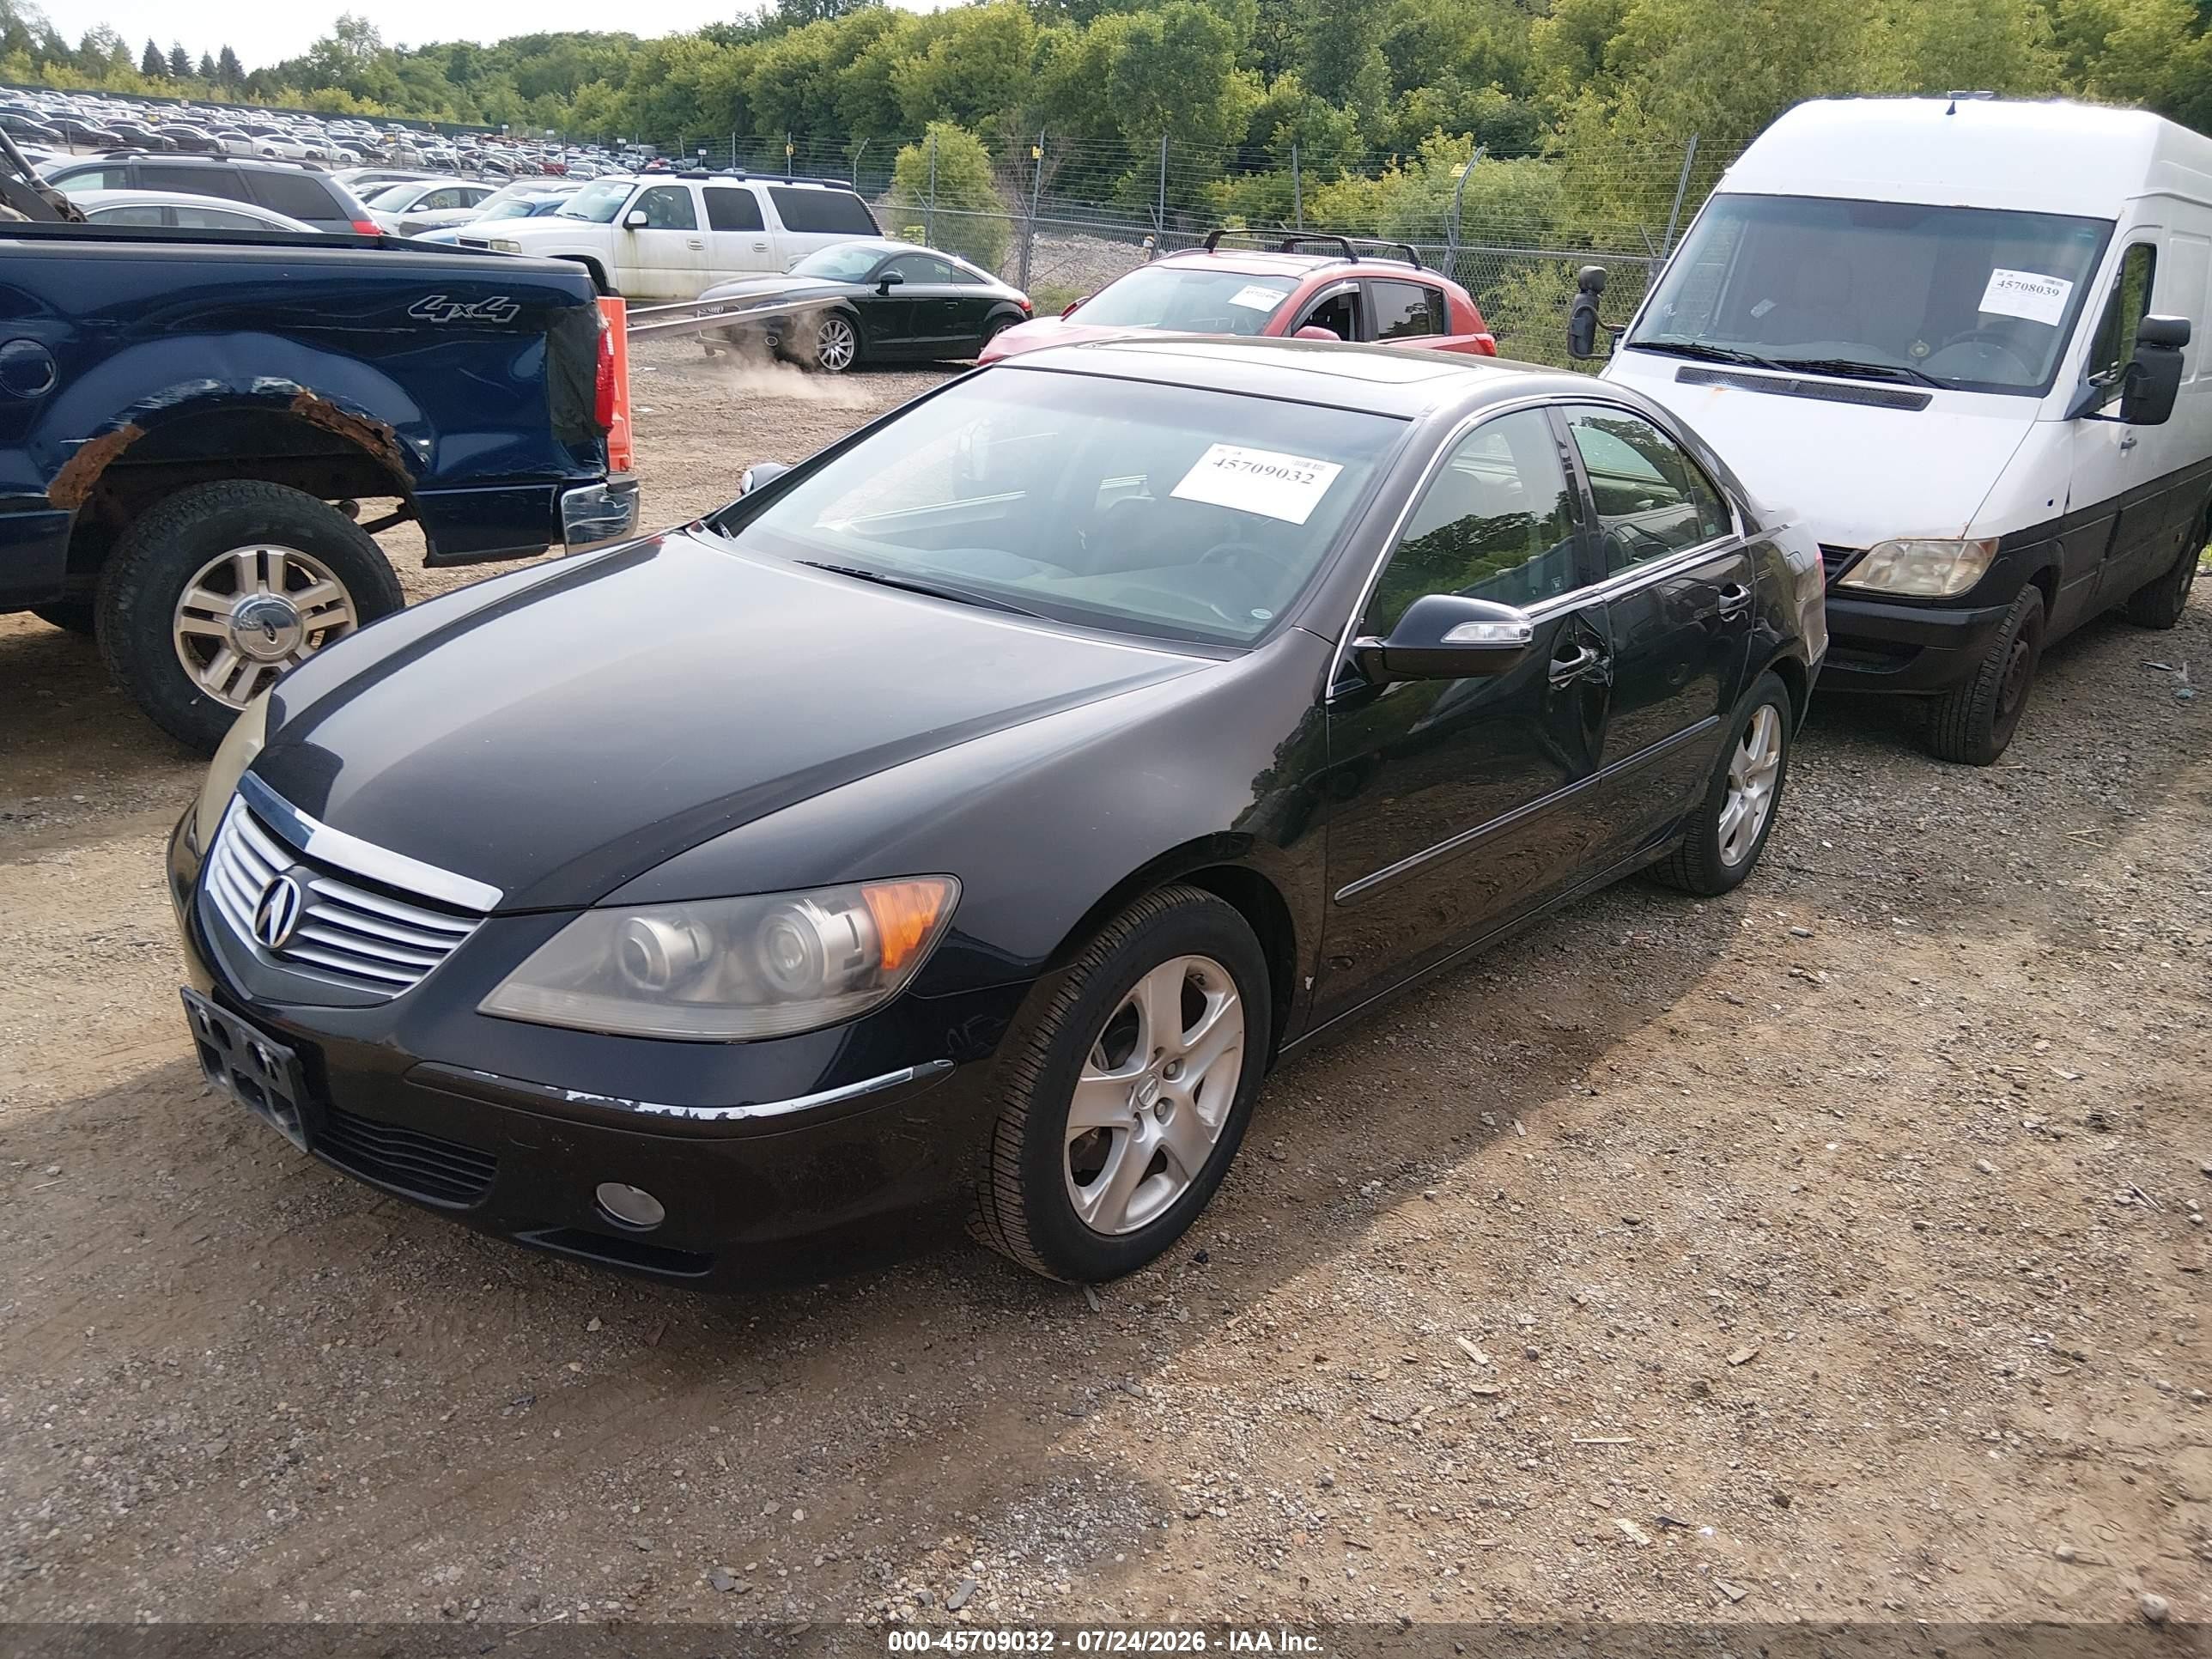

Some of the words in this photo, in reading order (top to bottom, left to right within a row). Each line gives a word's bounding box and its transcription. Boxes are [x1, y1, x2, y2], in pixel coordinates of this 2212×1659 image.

[1996, 280, 2060, 297] 45708039
[407, 295, 520, 322] 4x4
[1212, 458, 1315, 485] 45709032
